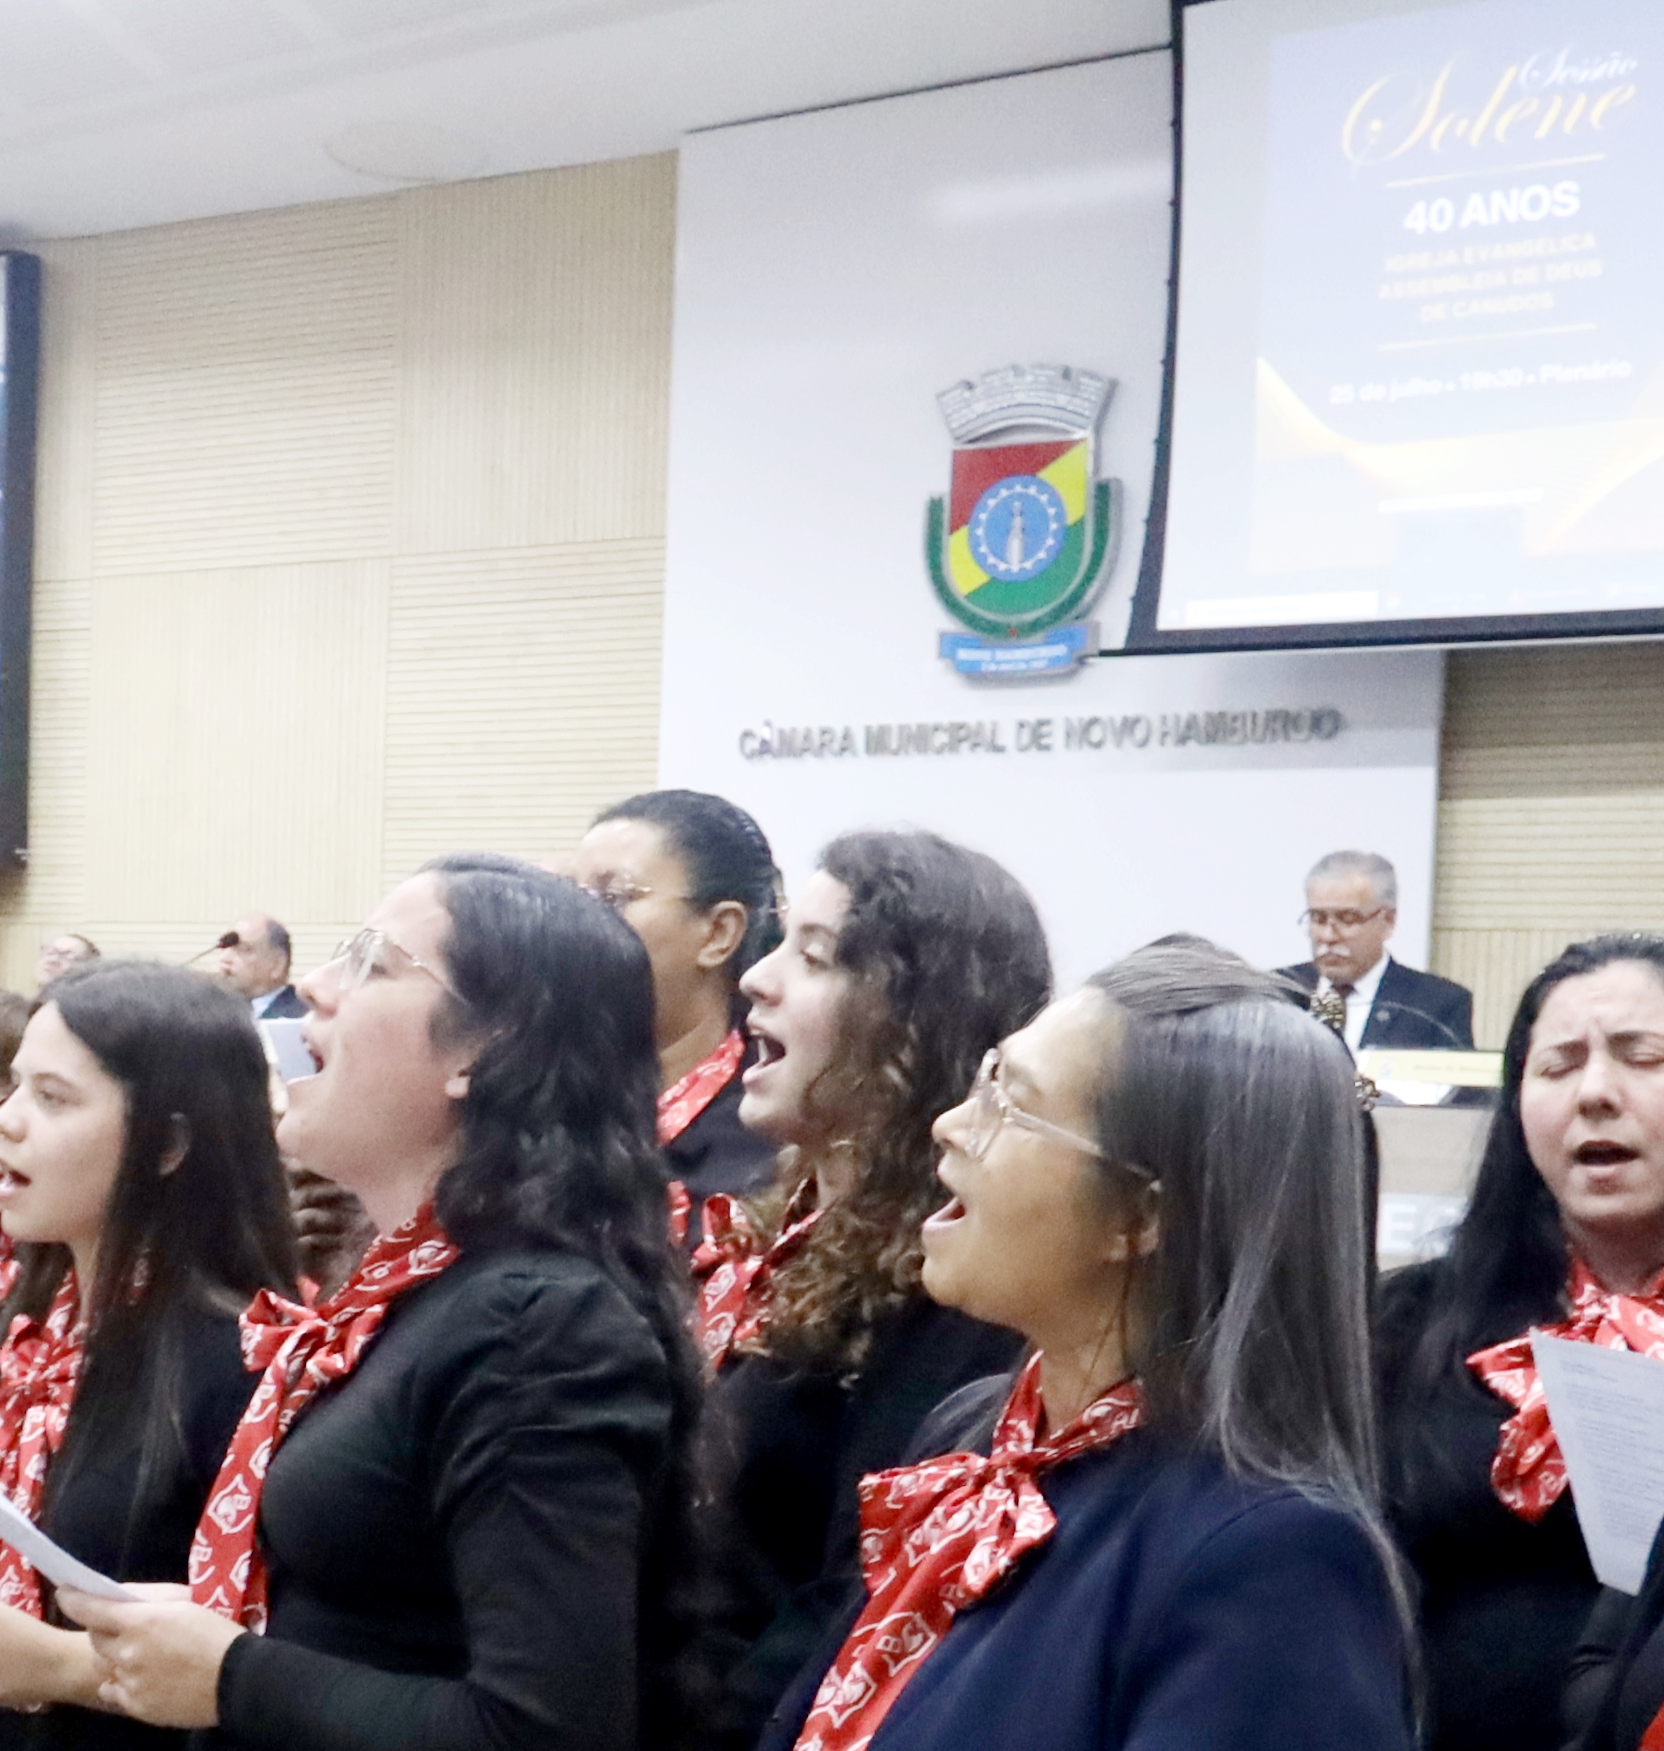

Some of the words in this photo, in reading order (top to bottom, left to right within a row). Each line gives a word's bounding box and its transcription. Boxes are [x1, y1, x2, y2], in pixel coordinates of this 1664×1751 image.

[1341, 49, 1637, 169] Solene
[1402, 199, 1455, 235] 40
[1458, 180, 1582, 230] ANOS
[865, 720, 1007, 757] MUNICIPAL
[1015, 717, 1055, 752] DE
[1063, 714, 1153, 751] NOVO
[1159, 706, 1345, 748] HAMBURGO
